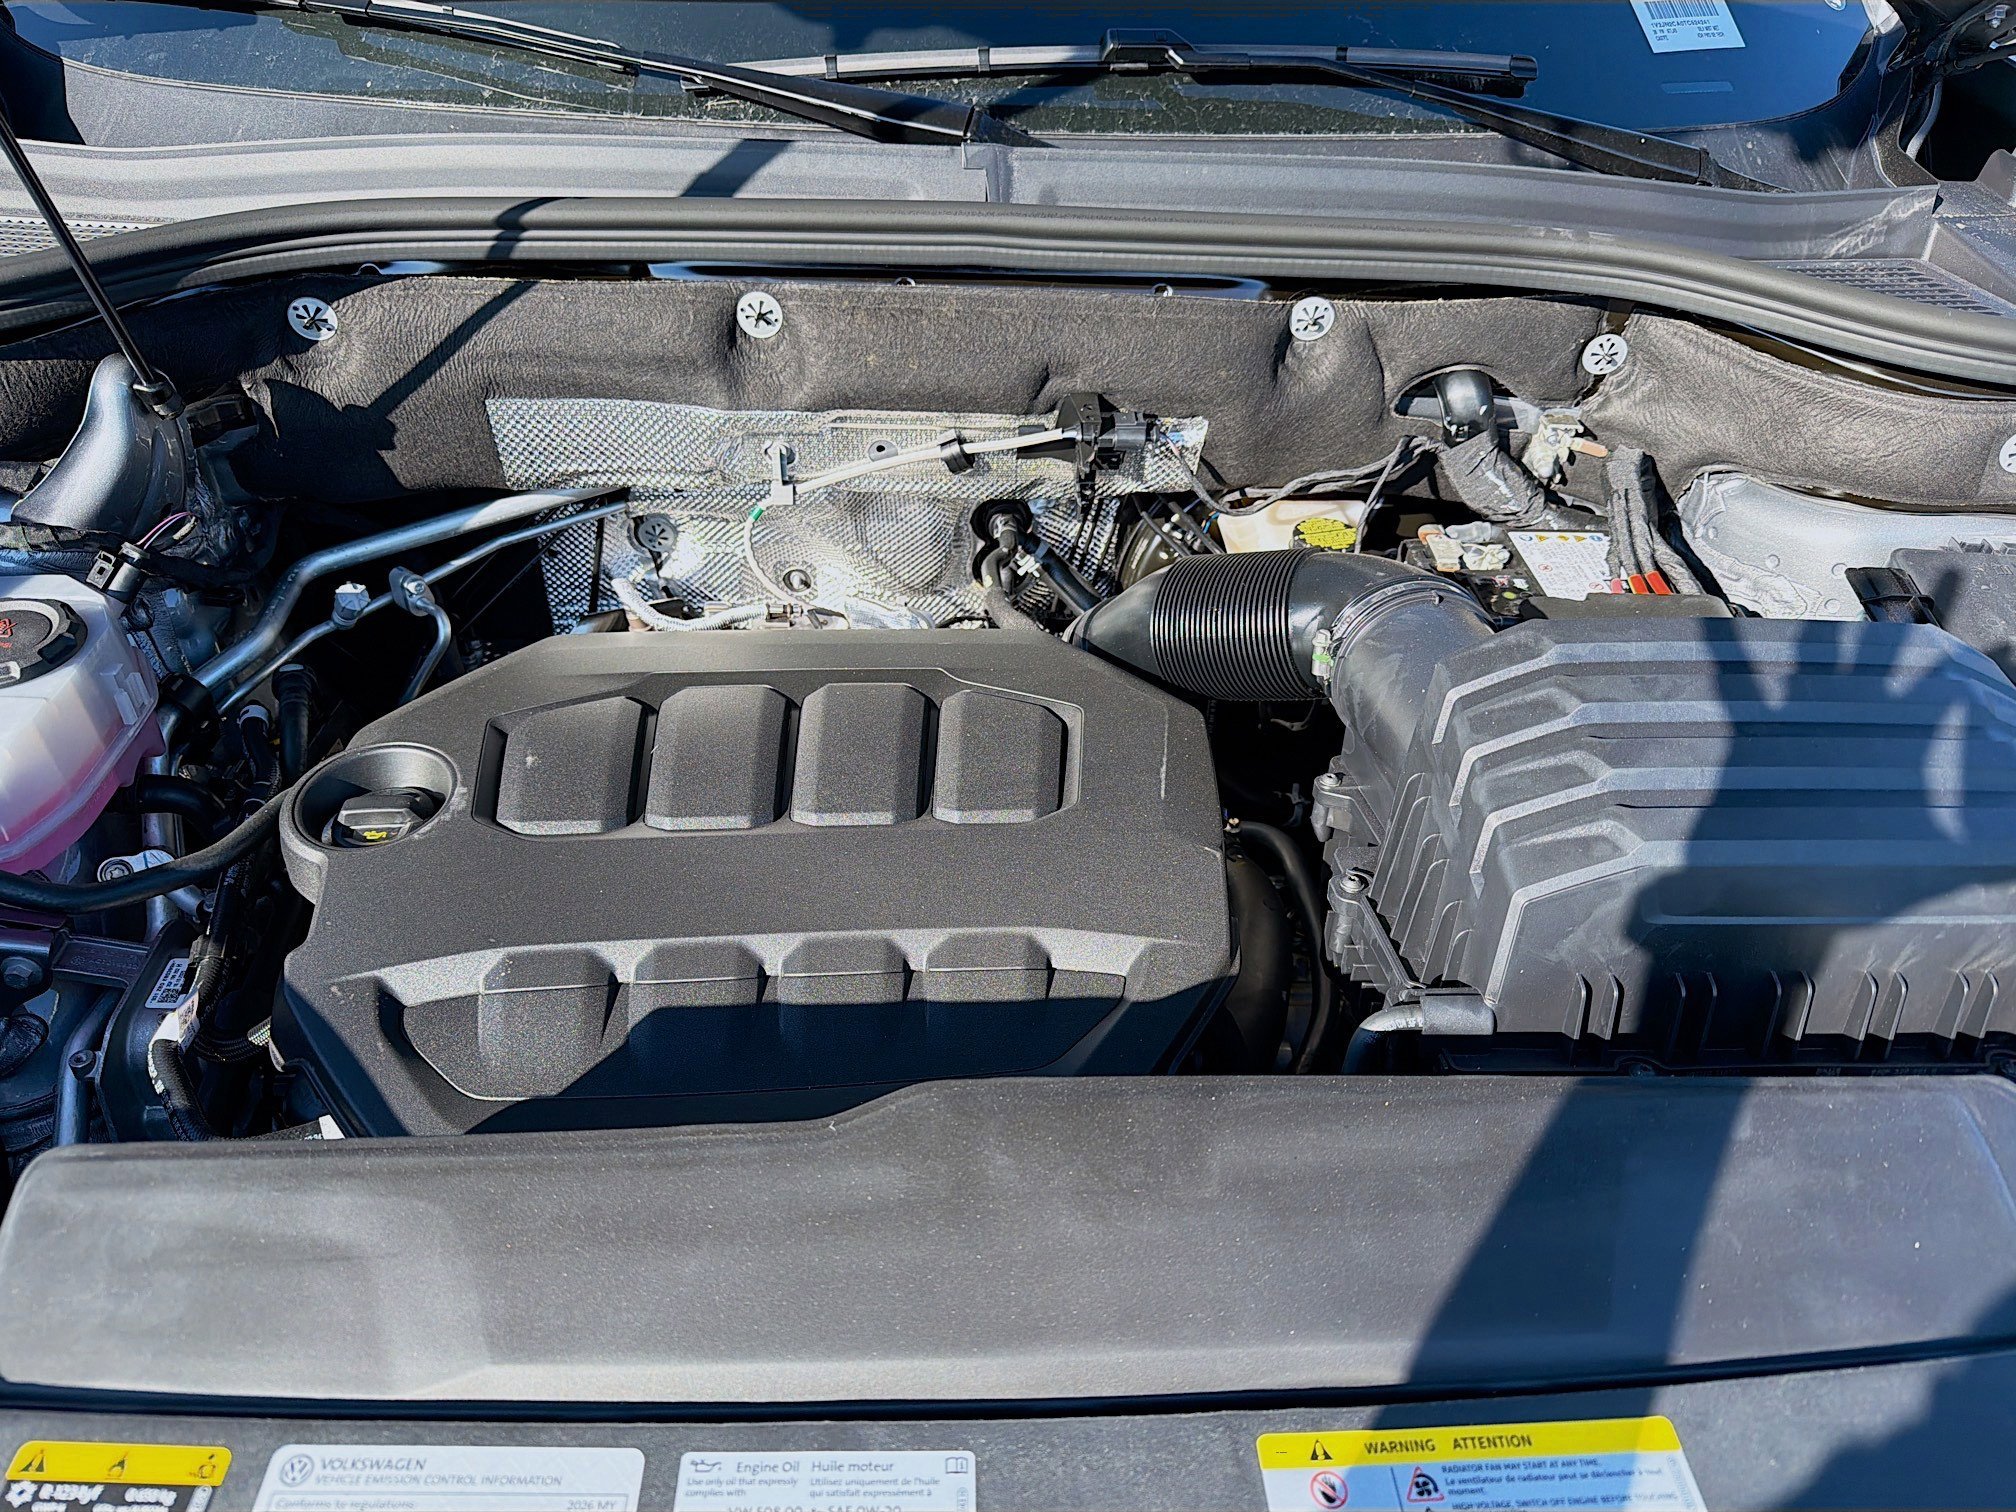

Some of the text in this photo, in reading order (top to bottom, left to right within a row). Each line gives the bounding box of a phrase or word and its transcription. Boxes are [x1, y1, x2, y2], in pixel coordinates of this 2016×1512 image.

[1364, 1434, 1532, 1455] WARNING ATTENTION
[320, 1457, 427, 1471] VOLKSWAGEN
[736, 1460, 800, 1475] Engine Oil
[811, 1461, 895, 1472] Huile moteur
[1441, 1463, 1483, 1473] RADIATOR
[1485, 1462, 1502, 1471] FAN
[315, 1474, 562, 1486] VEHICLE EMISSION CONTROL INFORMATION
